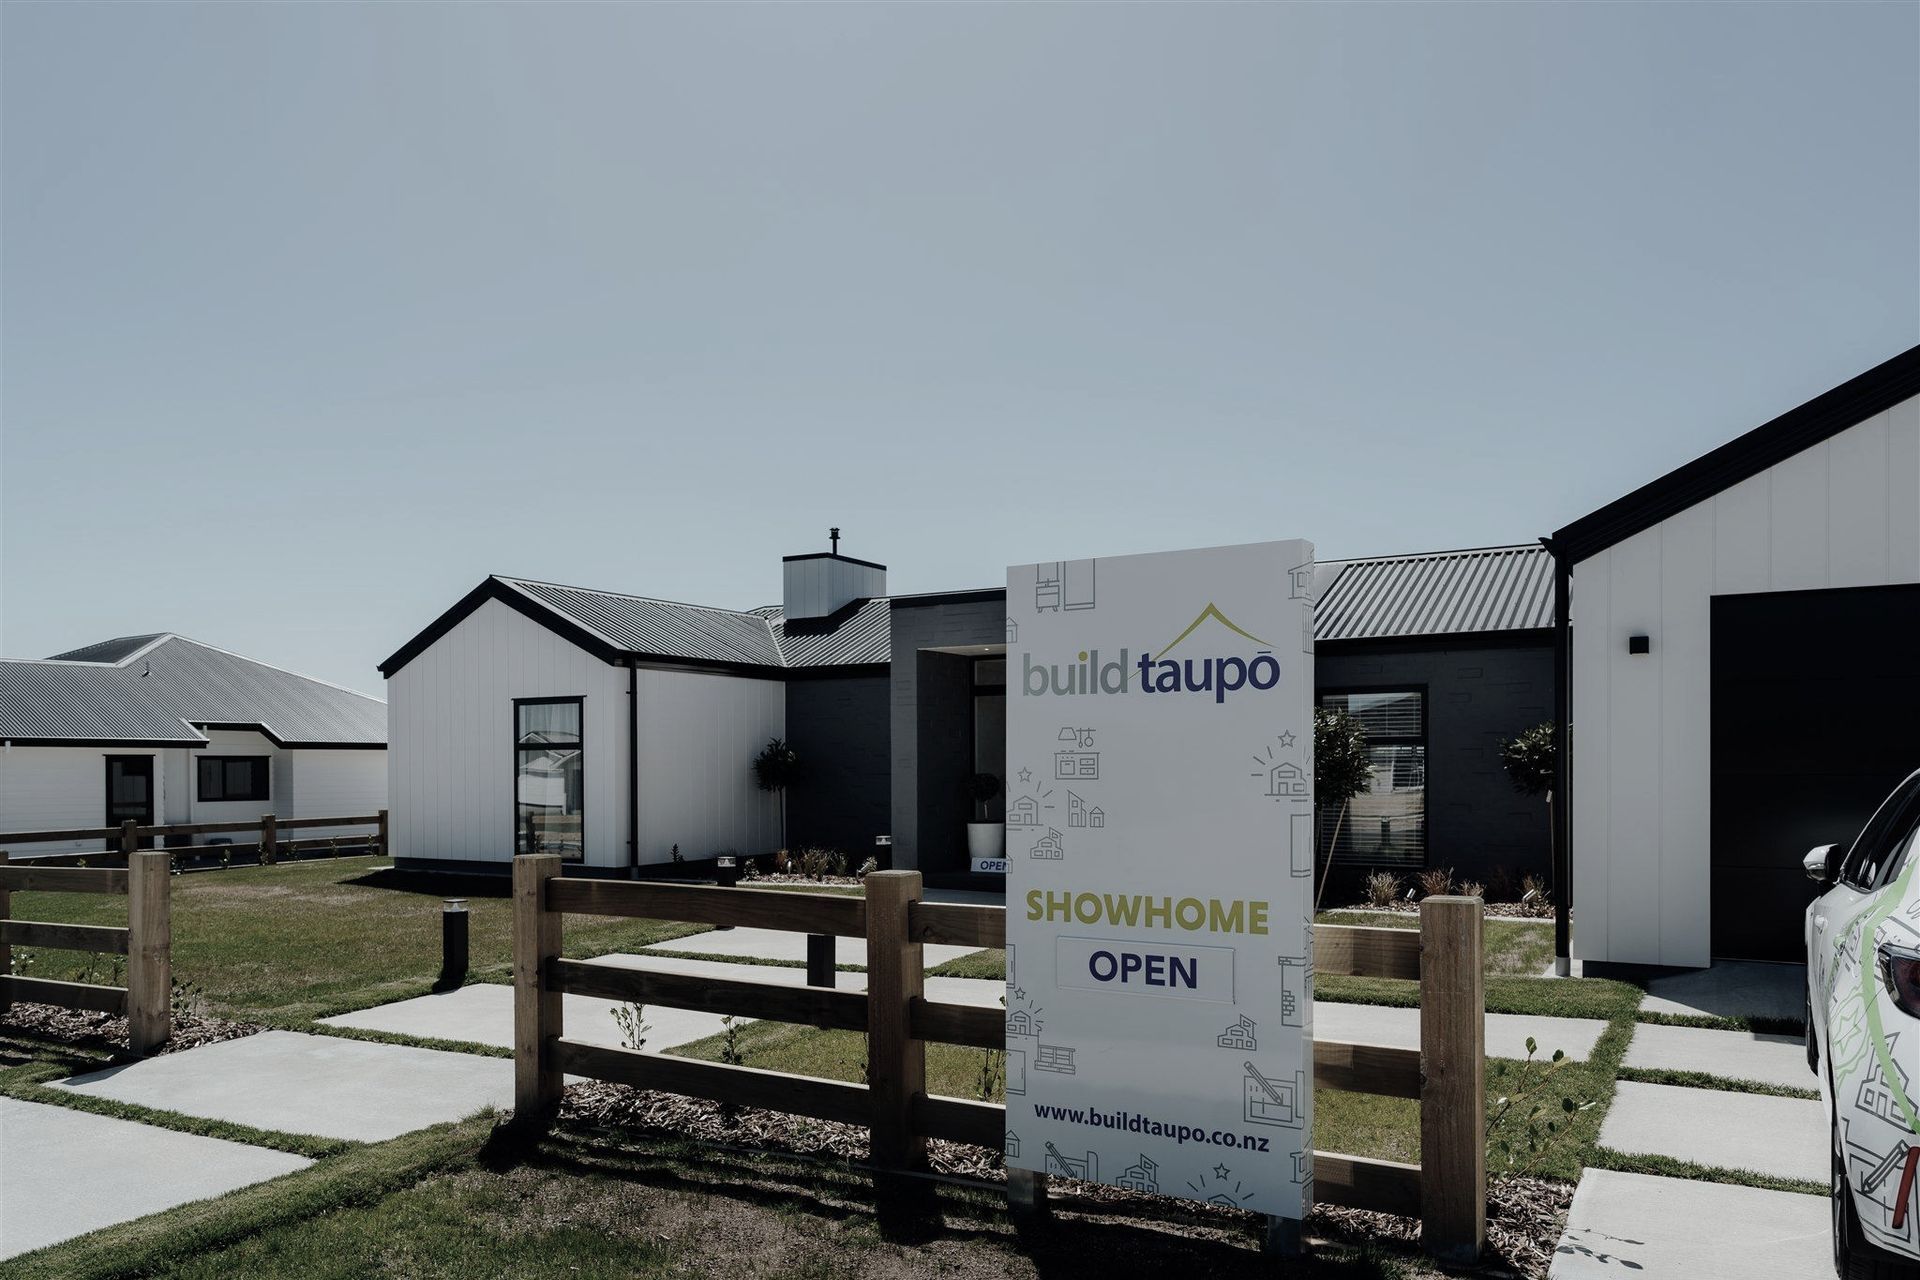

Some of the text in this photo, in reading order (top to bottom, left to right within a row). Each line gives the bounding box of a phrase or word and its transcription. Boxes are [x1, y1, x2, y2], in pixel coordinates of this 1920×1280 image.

[1023, 648, 1280, 704] build taupō
[1026, 889, 1269, 935] SHOWHOME
[1089, 951, 1197, 989] OPEN
[1034, 1103, 1270, 1152] www.buildtaupo.co.nz
